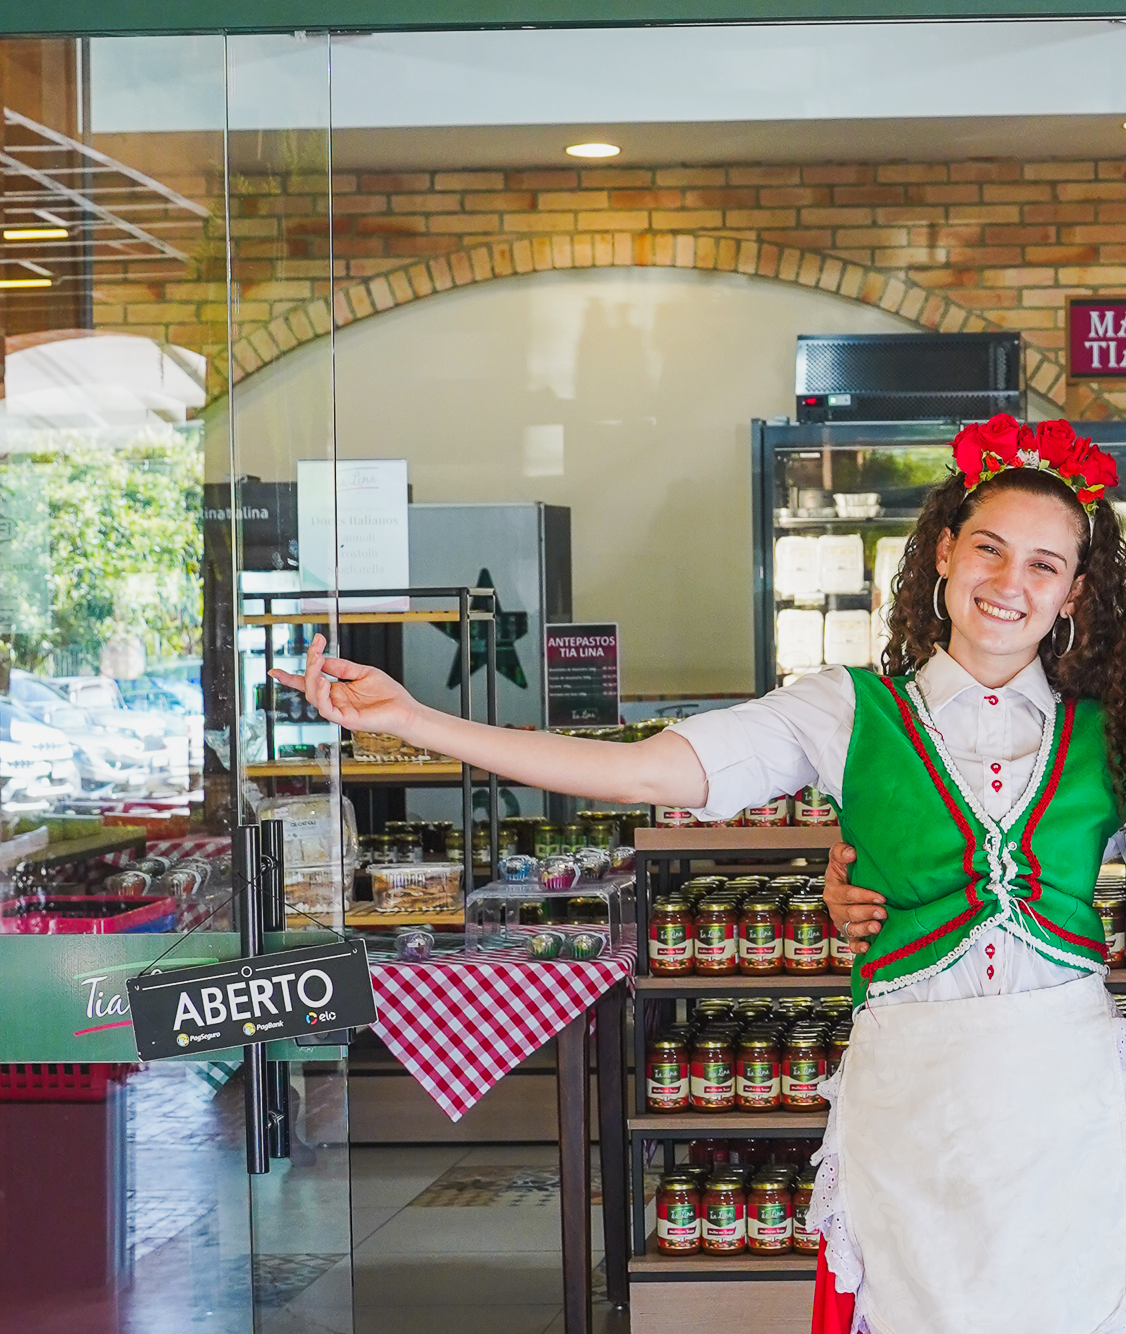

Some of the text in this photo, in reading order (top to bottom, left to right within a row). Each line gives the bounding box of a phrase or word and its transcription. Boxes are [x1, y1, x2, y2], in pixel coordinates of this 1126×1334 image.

[311, 516, 346, 525] Docs
[548, 636, 616, 647] ANTEPASTOS
[559, 648, 604, 657] TIA LINA
[81, 976, 129, 1018] Tia
[173, 969, 333, 1031] ABERTO
[319, 1011, 336, 1022] elo
[256, 1020, 284, 1032] PagBank
[190, 1032, 221, 1044] PagSeguro
